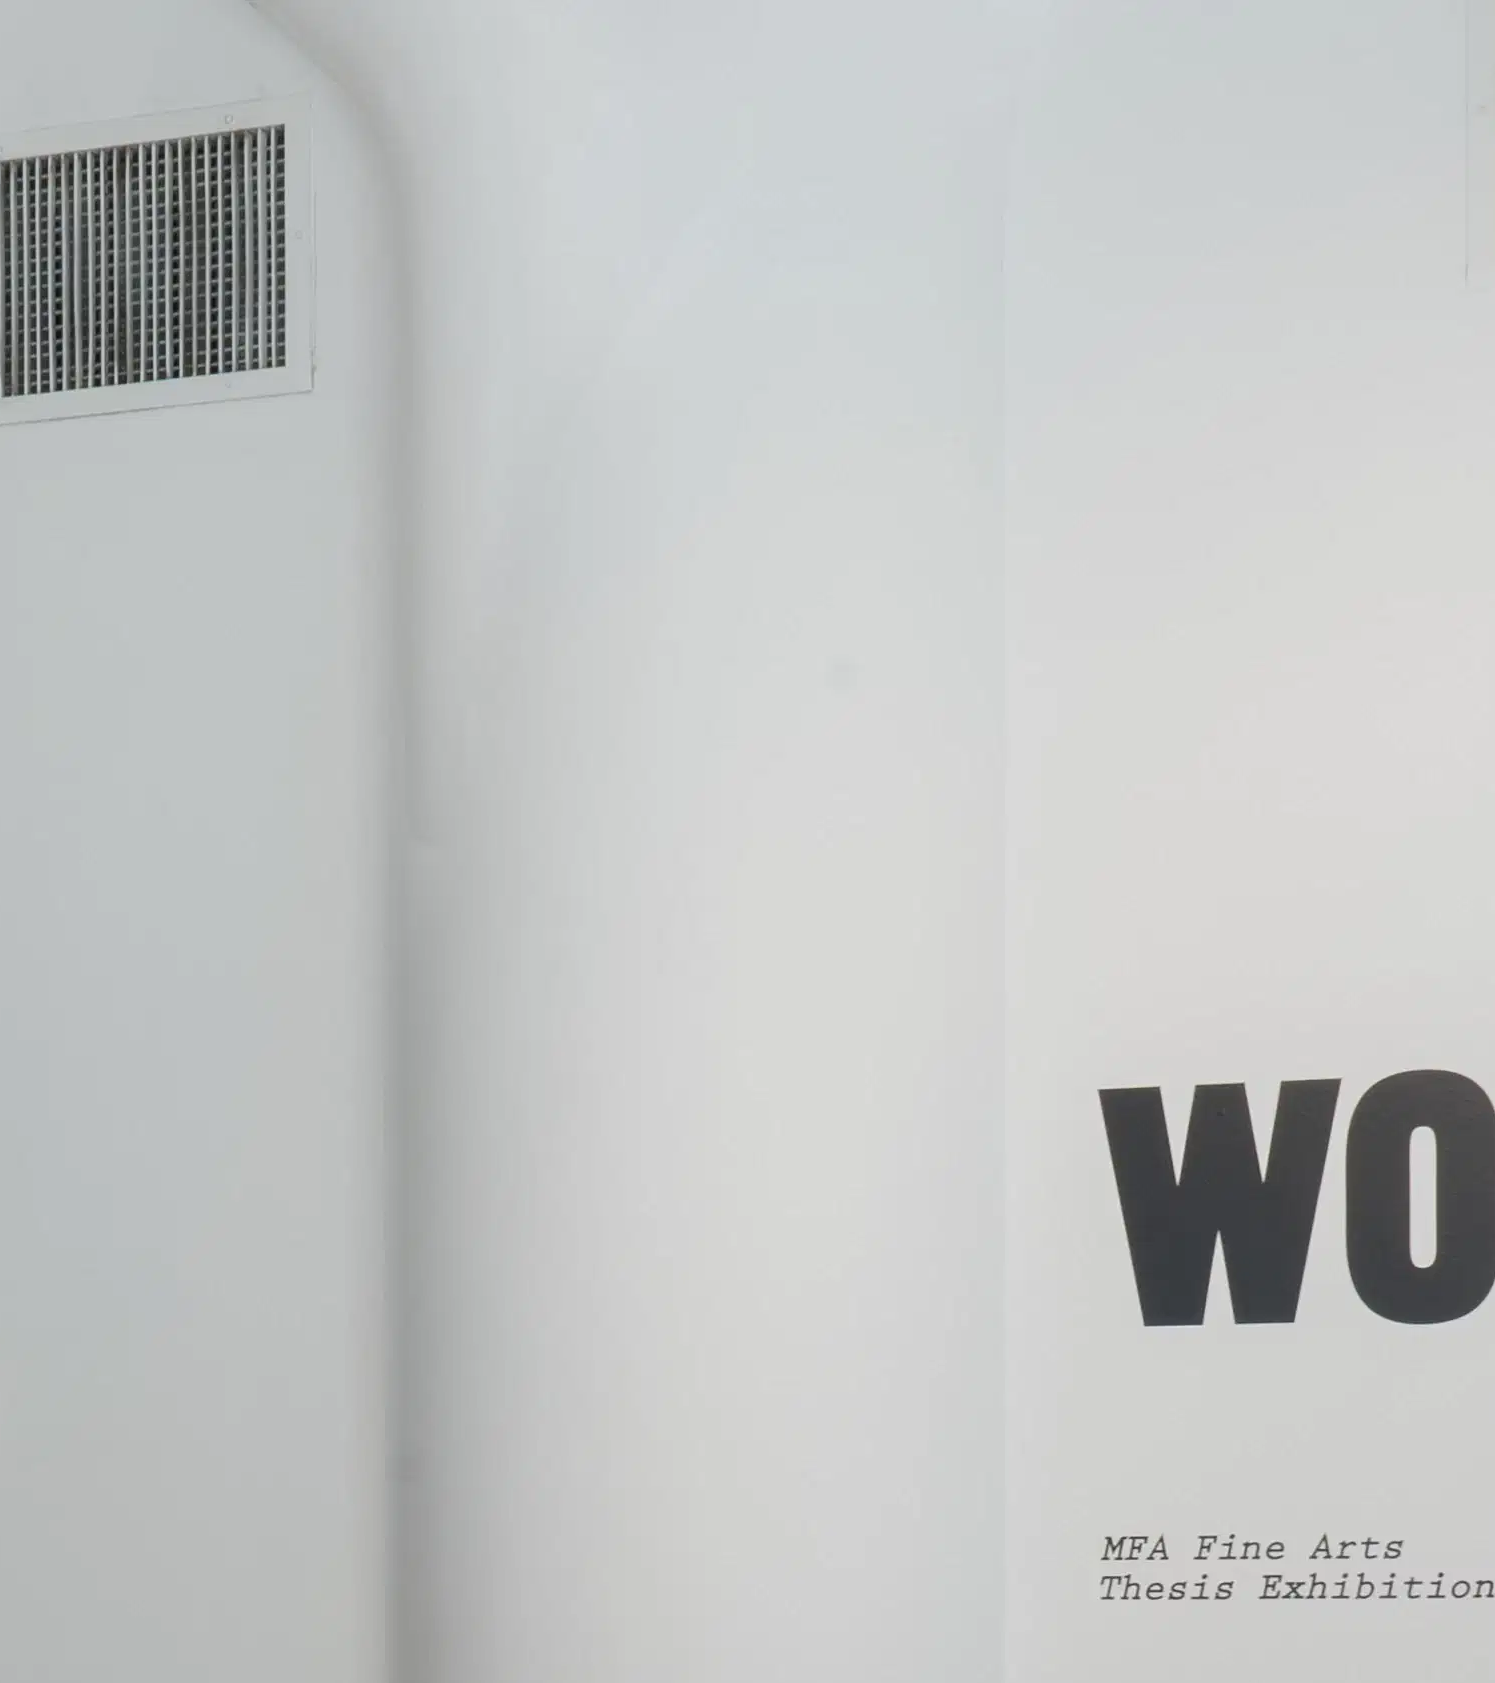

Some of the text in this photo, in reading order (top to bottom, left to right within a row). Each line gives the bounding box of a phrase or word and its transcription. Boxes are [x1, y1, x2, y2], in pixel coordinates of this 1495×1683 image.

[1100, 1532, 1404, 1561] MFA Fine Arts
[1100, 1571, 1495, 1601] Thesis Exhibition
